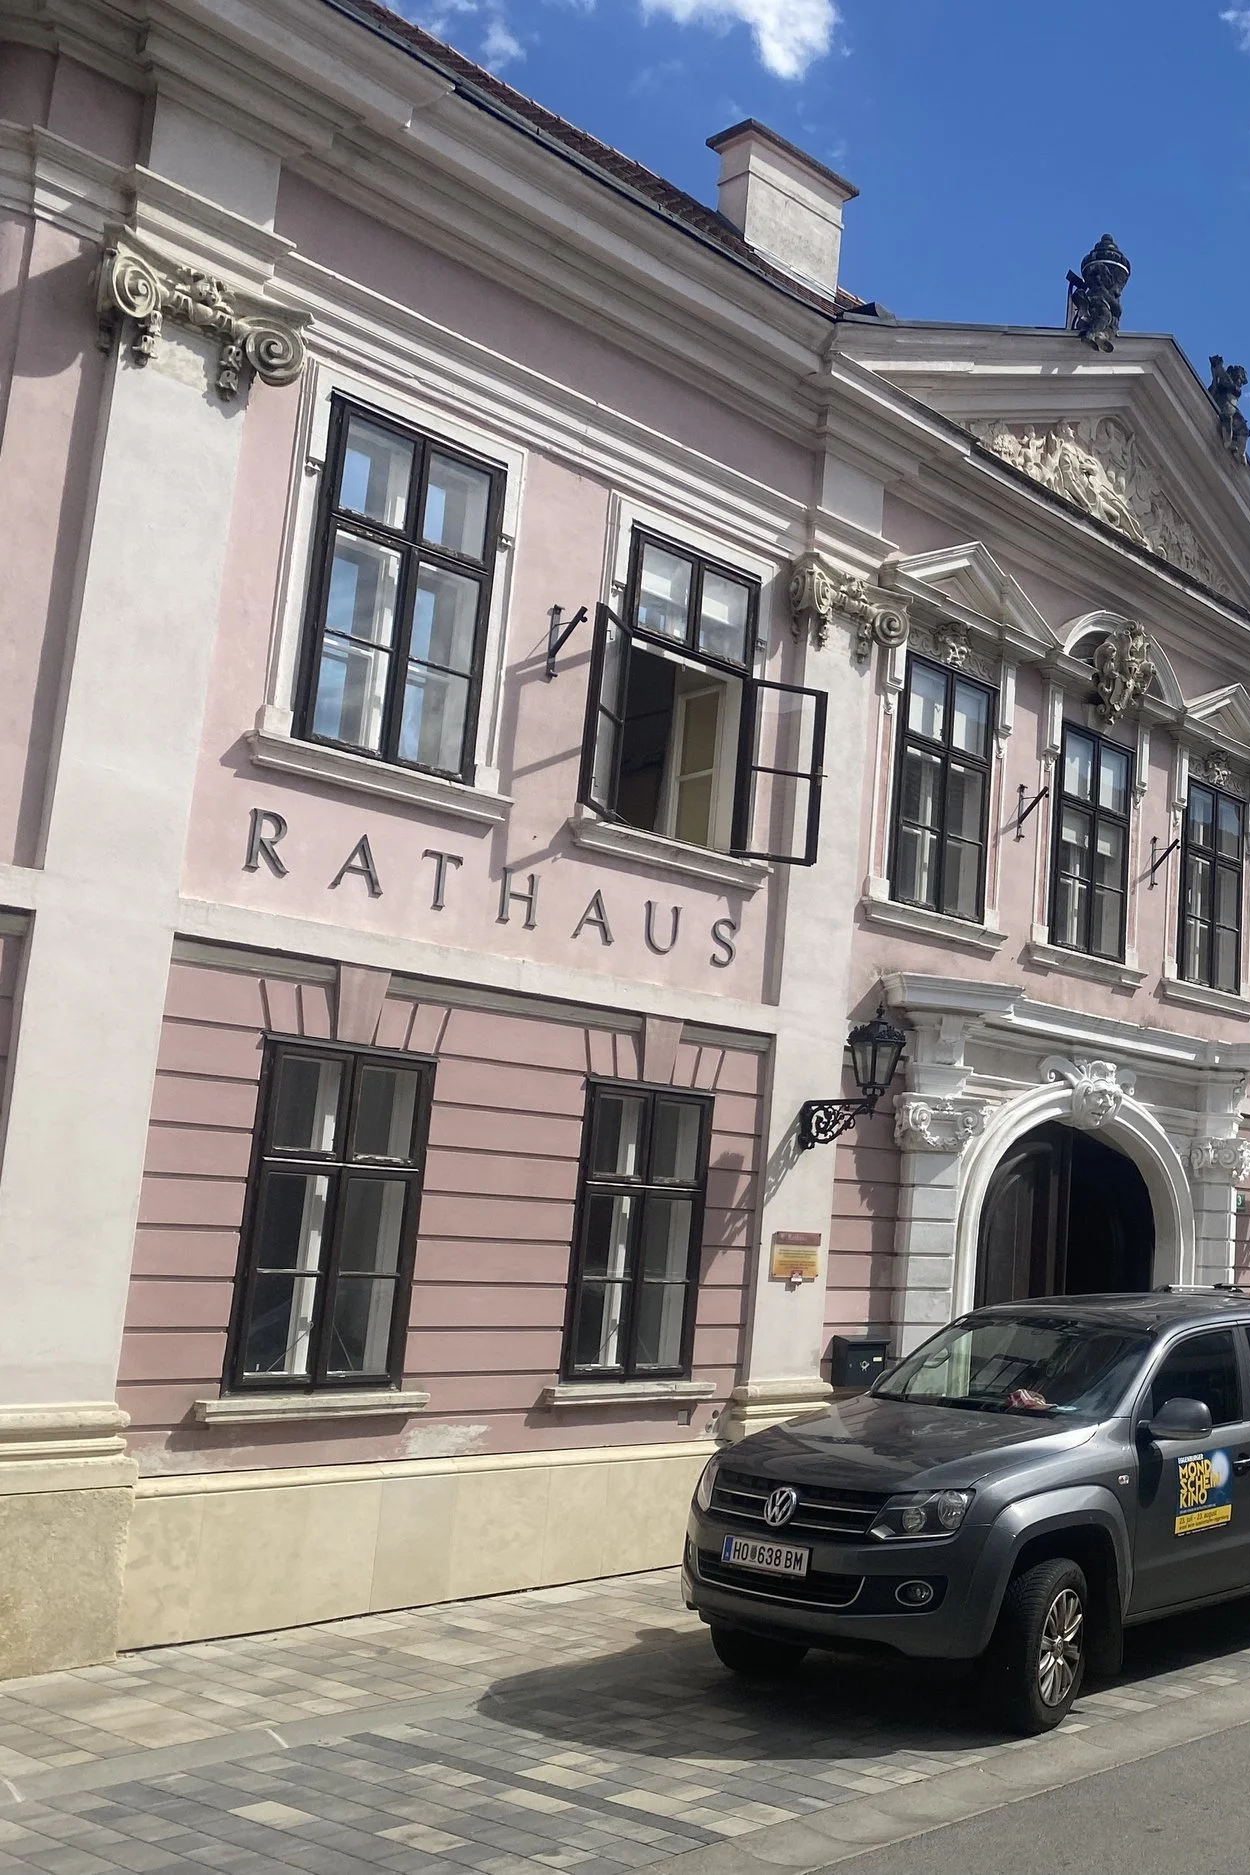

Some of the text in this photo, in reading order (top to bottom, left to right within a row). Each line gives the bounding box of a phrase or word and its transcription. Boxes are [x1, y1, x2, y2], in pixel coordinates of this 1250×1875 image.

[241, 807, 738, 969] RATHAUS
[1179, 1459, 1212, 1479] MOND
[1180, 1472, 1220, 1493] SCHEIN
[1180, 1489, 1208, 1508] KINO
[733, 1541, 803, 1571] HO 638 BM
